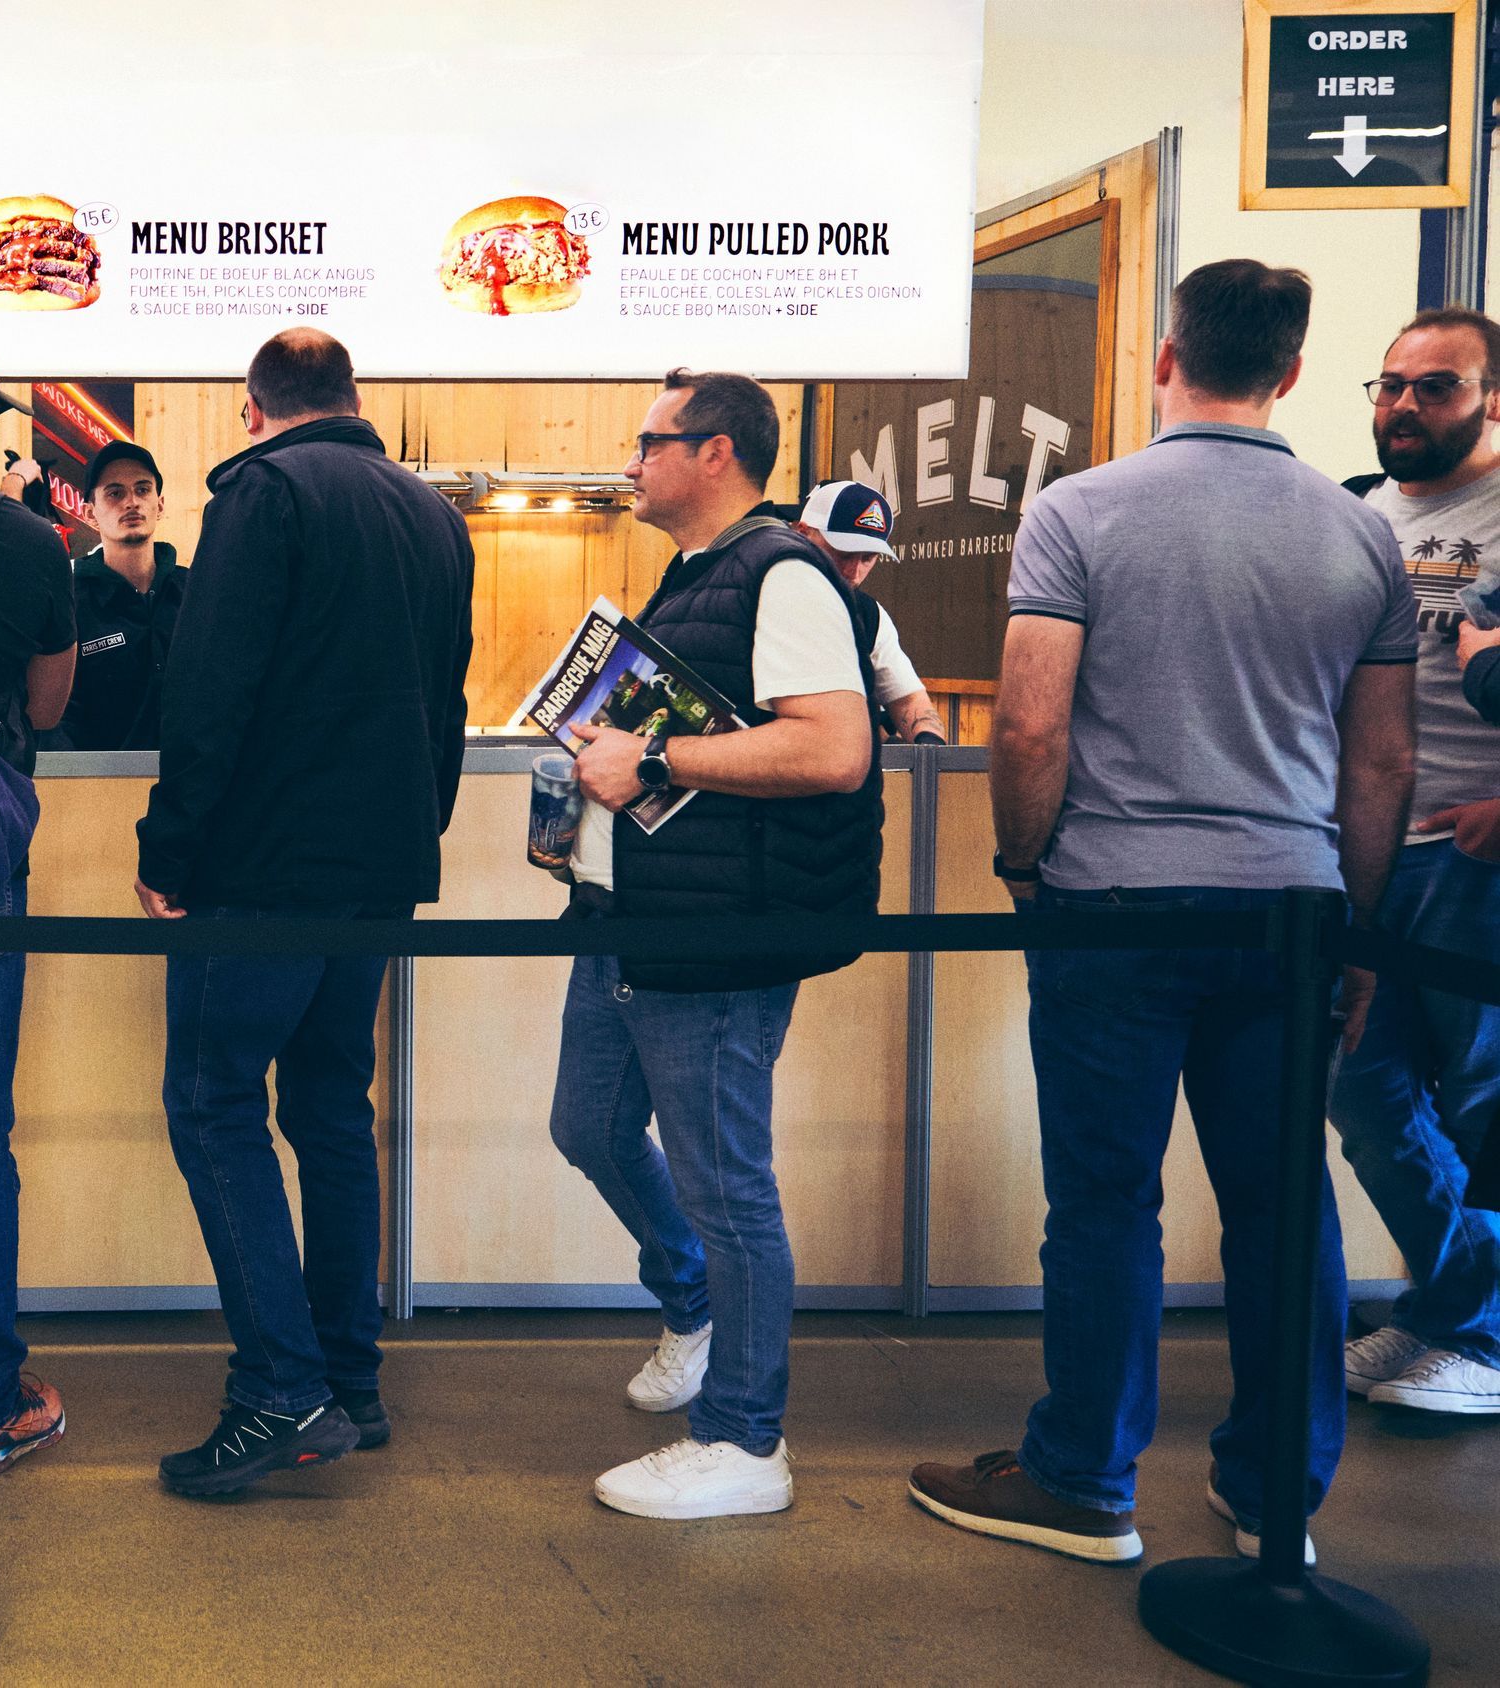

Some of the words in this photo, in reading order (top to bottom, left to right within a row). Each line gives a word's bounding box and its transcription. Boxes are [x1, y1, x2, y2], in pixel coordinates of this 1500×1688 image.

[1308, 29, 1408, 50] ORDER
[1317, 76, 1396, 97] HERE
[80, 208, 113, 227] 15€
[570, 210, 602, 230] 13€
[131, 222, 208, 255] MENU
[218, 222, 327, 255] BRISKET
[622, 222, 699, 255] MENU
[709, 222, 809, 255] PULLED
[818, 222, 889, 256] PORK
[131, 268, 194, 280] POITRINE
[200, 268, 217, 280] DE
[223, 268, 269, 280] BOEUF
[274, 268, 321, 280] BLACK
[326, 268, 374, 280] ANGUS
[681, 269, 698, 280] DE
[703, 269, 761, 281] COCHON
[819, 269, 836, 280] 8H
[841, 269, 858, 280] ET
[184, 285, 209, 298] 15H,
[215, 286, 274, 297] PICKLES
[279, 286, 366, 298] CONCOMBRE
[804, 286, 863, 298] PICKLES
[868, 286, 921, 298] OIGNON
[130, 303, 140, 315] &
[144, 303, 190, 315] SAUCE
[196, 303, 223, 316] BBQ
[228, 303, 281, 315] MAISON
[297, 303, 328, 315] SIDE
[620, 304, 628, 315] &
[634, 304, 680, 315] SAUCE
[685, 304, 712, 317] BBQ
[718, 304, 771, 316] MAISON
[787, 304, 818, 316] SIDE
[851, 396, 1071, 522] MELT
[911, 540, 954, 561] SMOKED
[959, 534, 1013, 556] BARBECU
[82, 643, 98, 653] PARIS
[98, 640, 107, 649] PIT
[106, 635, 123, 646] CREW
[534, 650, 595, 728] BARBECUE
[580, 619, 614, 660] MAG
[297, 1405, 325, 1432] SALOMON
